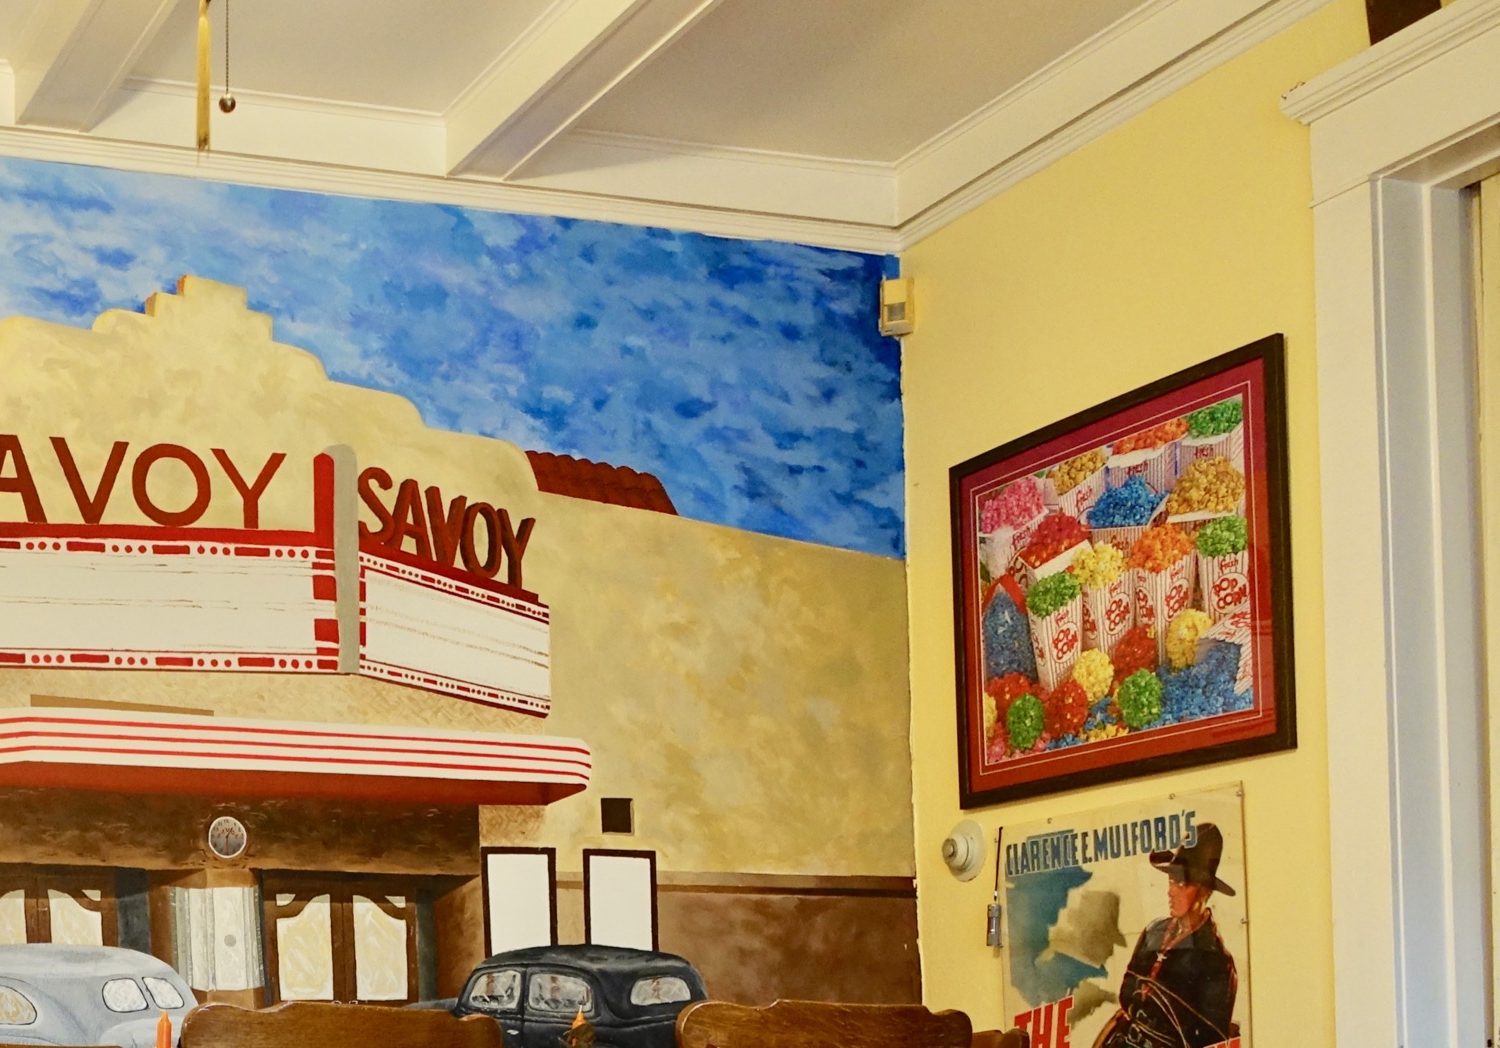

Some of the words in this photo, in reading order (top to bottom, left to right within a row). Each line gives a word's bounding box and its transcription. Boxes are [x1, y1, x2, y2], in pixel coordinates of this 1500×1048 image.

[358, 467, 536, 588] SAVOY
[1165, 584, 1183, 608] POP
[1213, 578, 1238, 597] POP
[1217, 584, 1247, 609] CORN
[1105, 598, 1122, 620] POP
[1052, 628, 1070, 650] POP
[1006, 833, 1078, 876] CLARENCE
[1094, 809, 1197, 862] MULFORD'S
